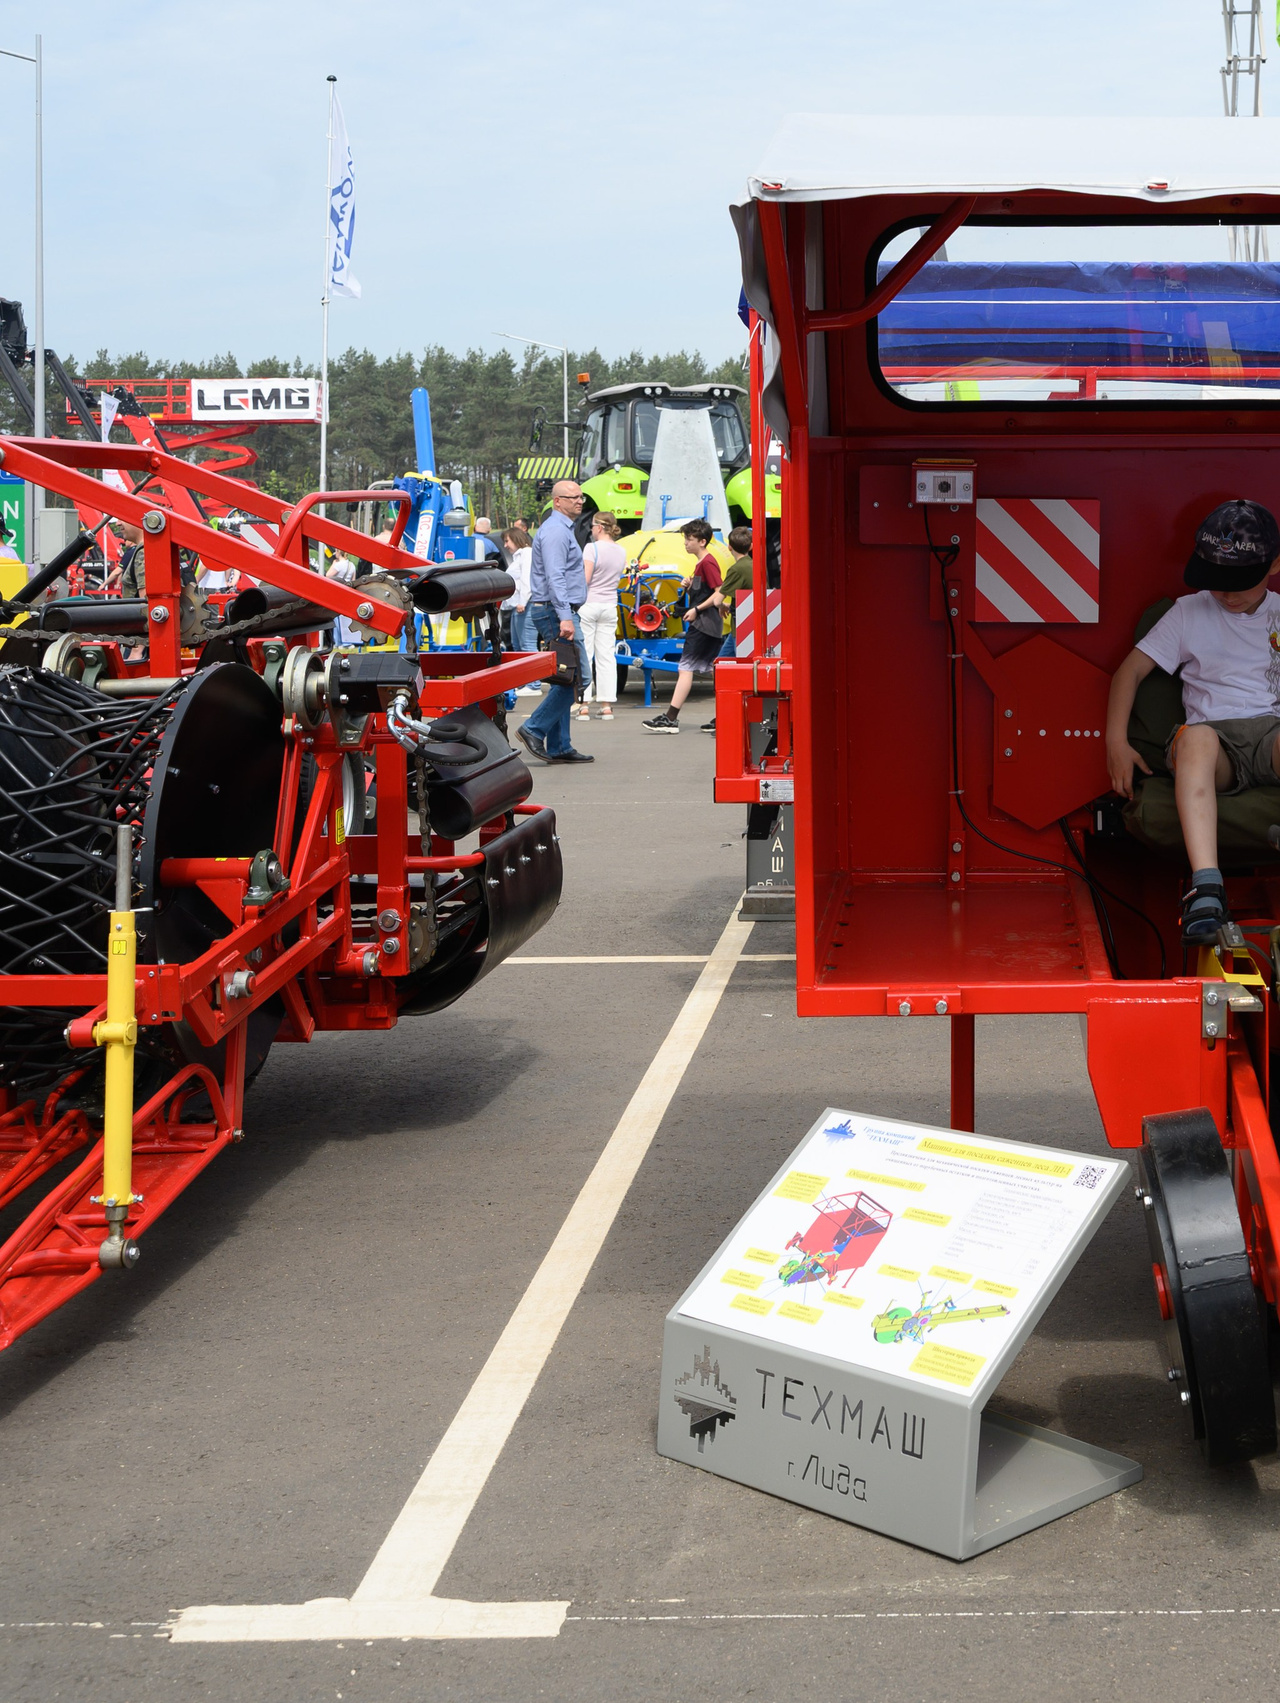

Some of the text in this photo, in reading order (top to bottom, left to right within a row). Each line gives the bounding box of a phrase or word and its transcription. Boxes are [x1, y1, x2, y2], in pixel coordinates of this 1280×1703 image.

[1234, 540, 1256, 552] AREA
[920, 1140, 954, 1152] Машина
[964, 1150, 997, 1161] посадки
[994, 1156, 1033, 1167] саженцев
[756, 1368, 925, 1460] ТЕХМАШ
[788, 1454, 867, 1502] г. Лида
